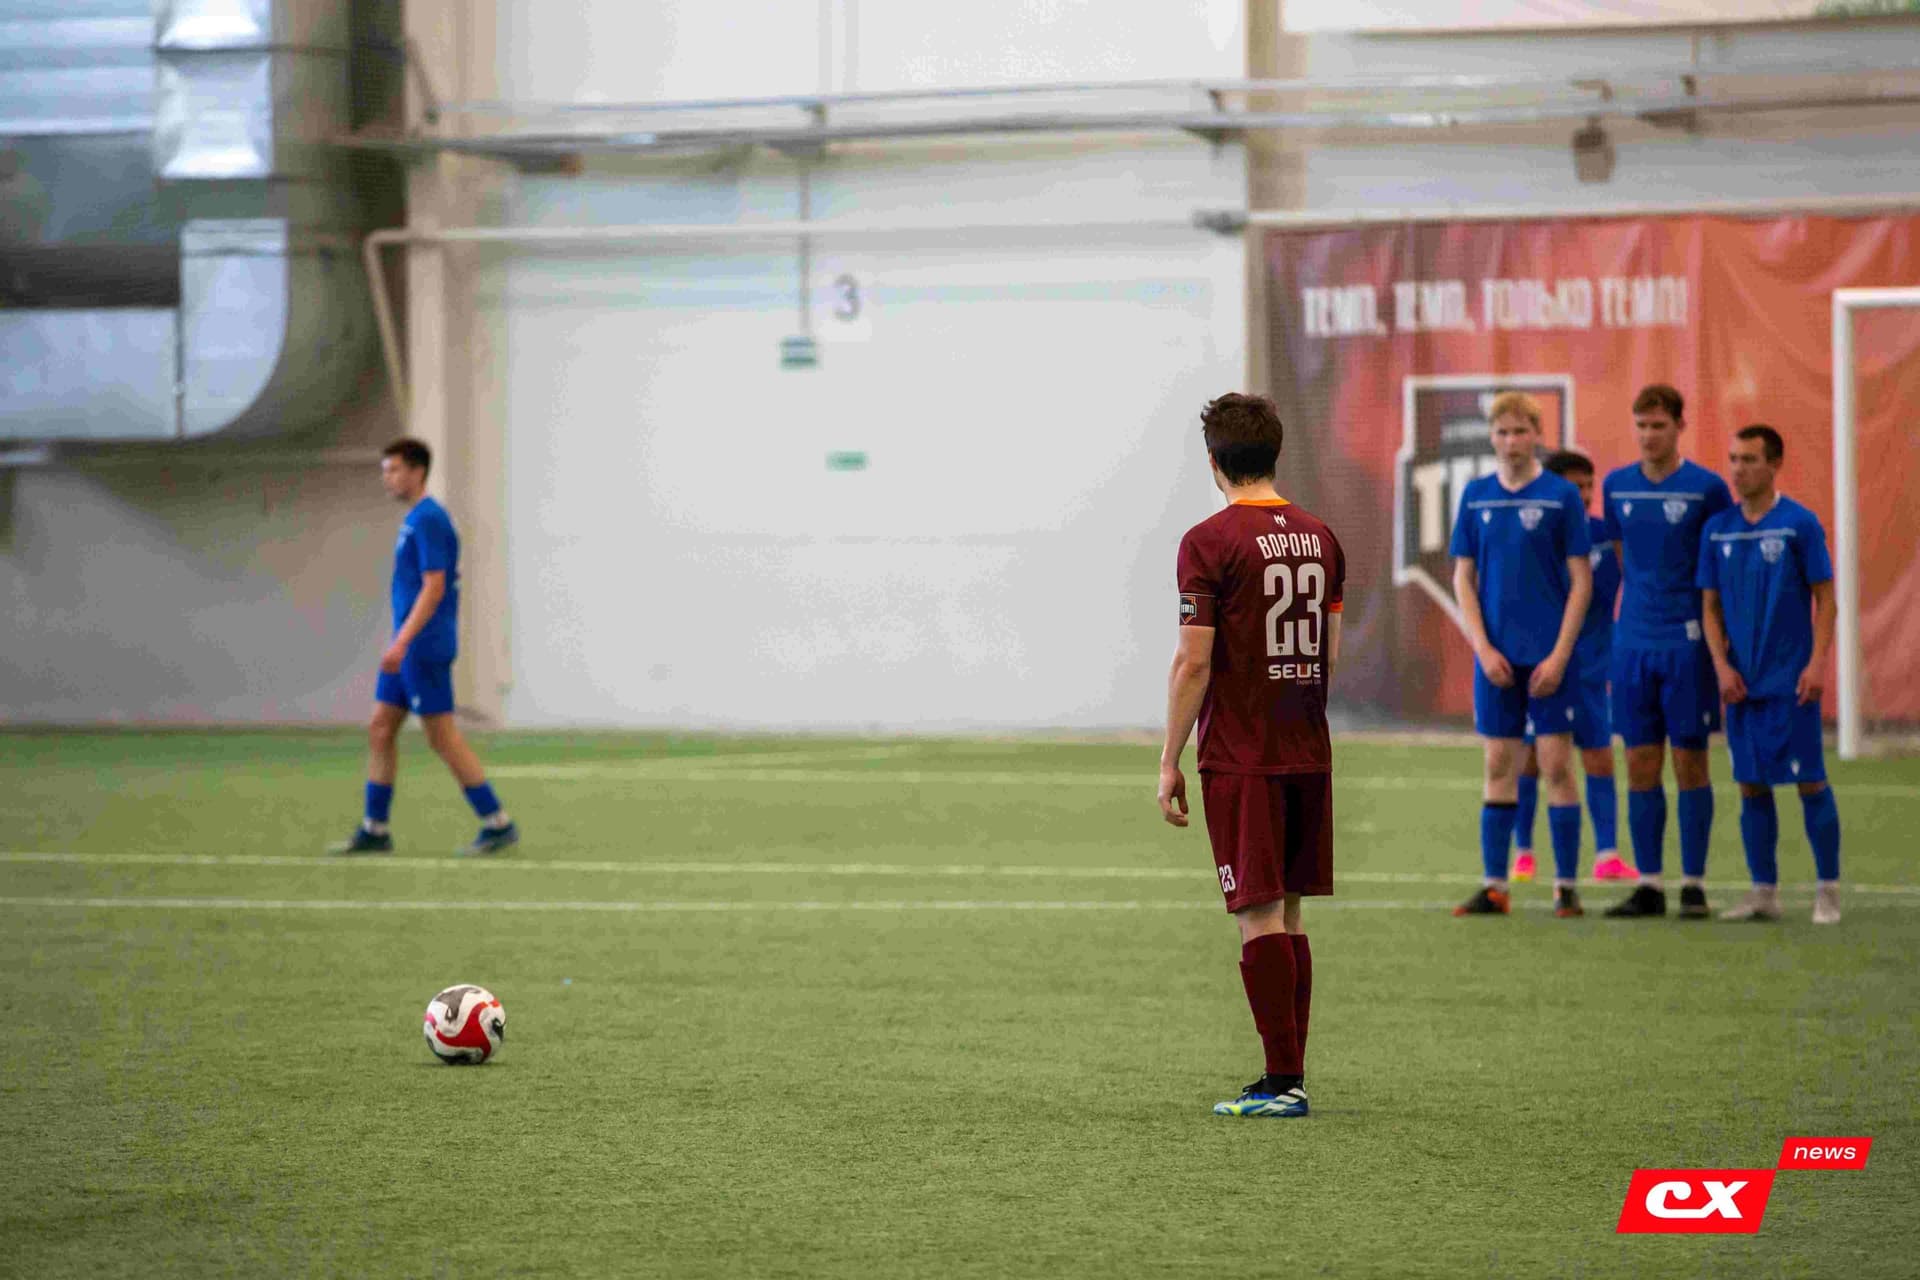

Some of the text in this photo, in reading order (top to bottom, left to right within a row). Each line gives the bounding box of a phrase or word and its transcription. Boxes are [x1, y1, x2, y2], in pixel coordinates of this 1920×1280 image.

[834, 272, 860, 322] 3
[1256, 533, 1322, 560] ВОРОНА
[1264, 562, 1326, 656] 23
[1219, 864, 1236, 892] 23
